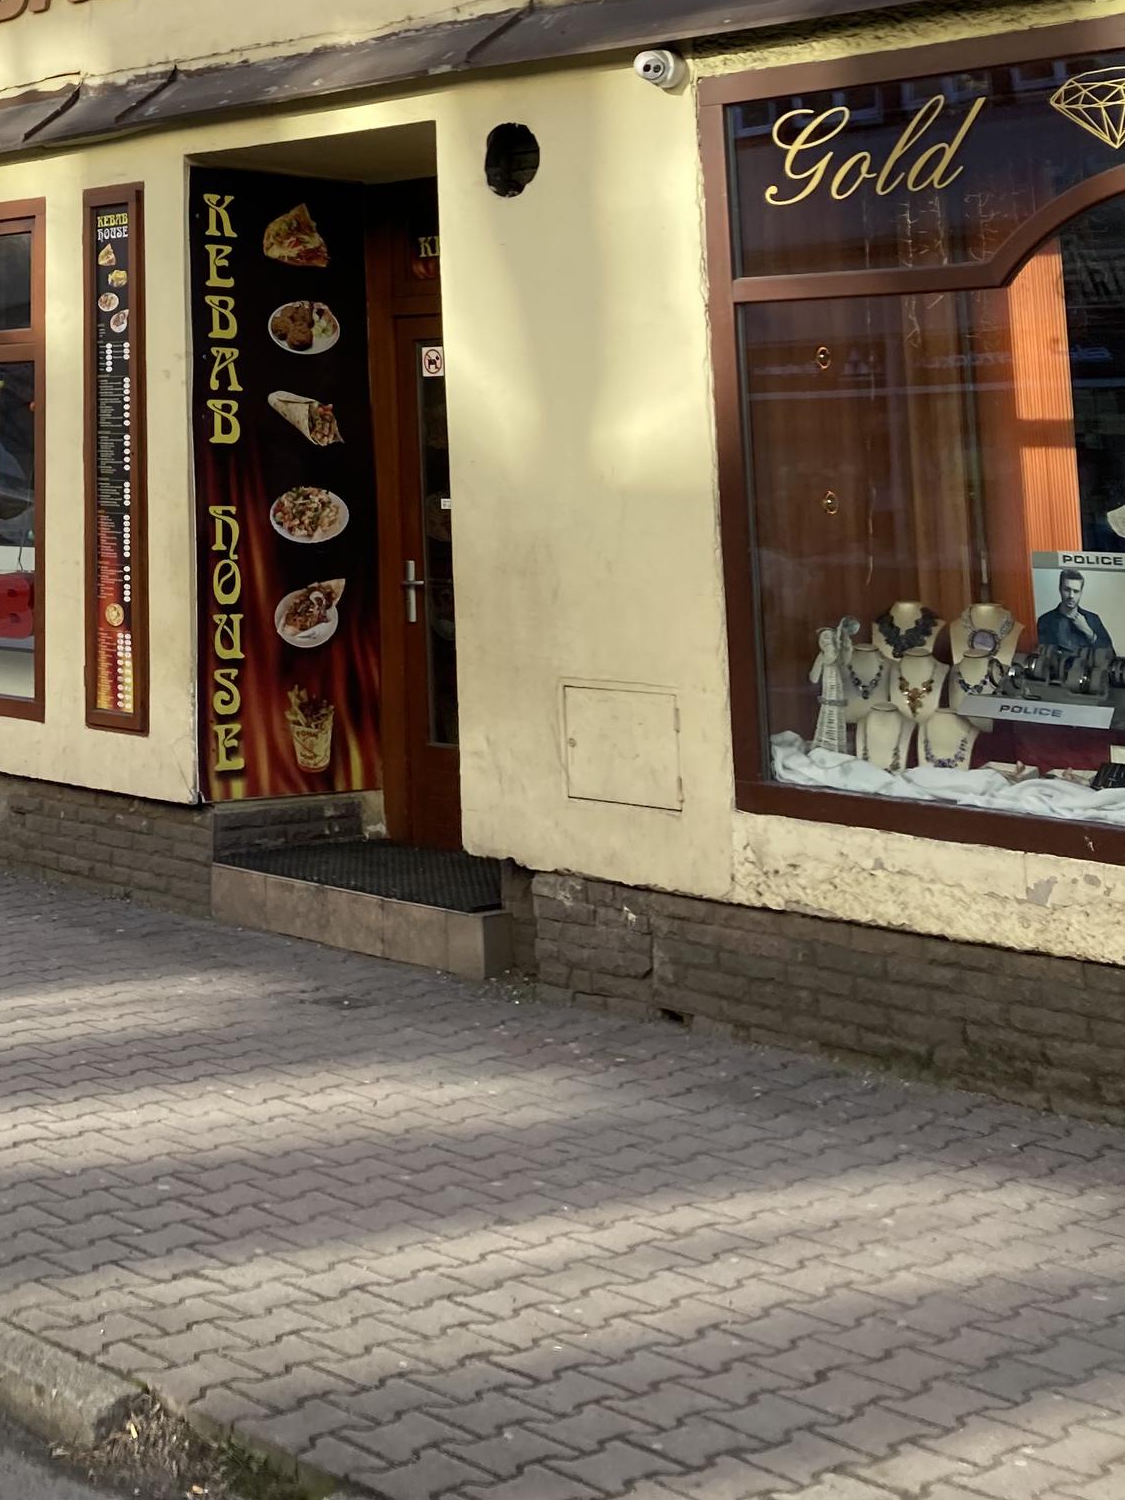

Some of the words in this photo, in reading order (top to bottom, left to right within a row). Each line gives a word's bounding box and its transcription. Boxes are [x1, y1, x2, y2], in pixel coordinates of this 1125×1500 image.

[764, 93, 987, 208] Gold
[97, 213, 128, 227] KEBAB
[203, 193, 245, 444] KEBAB
[1062, 553, 1125, 567] POLICE
[208, 505, 246, 772] HOUSE
[999, 703, 1063, 718] POLICE
